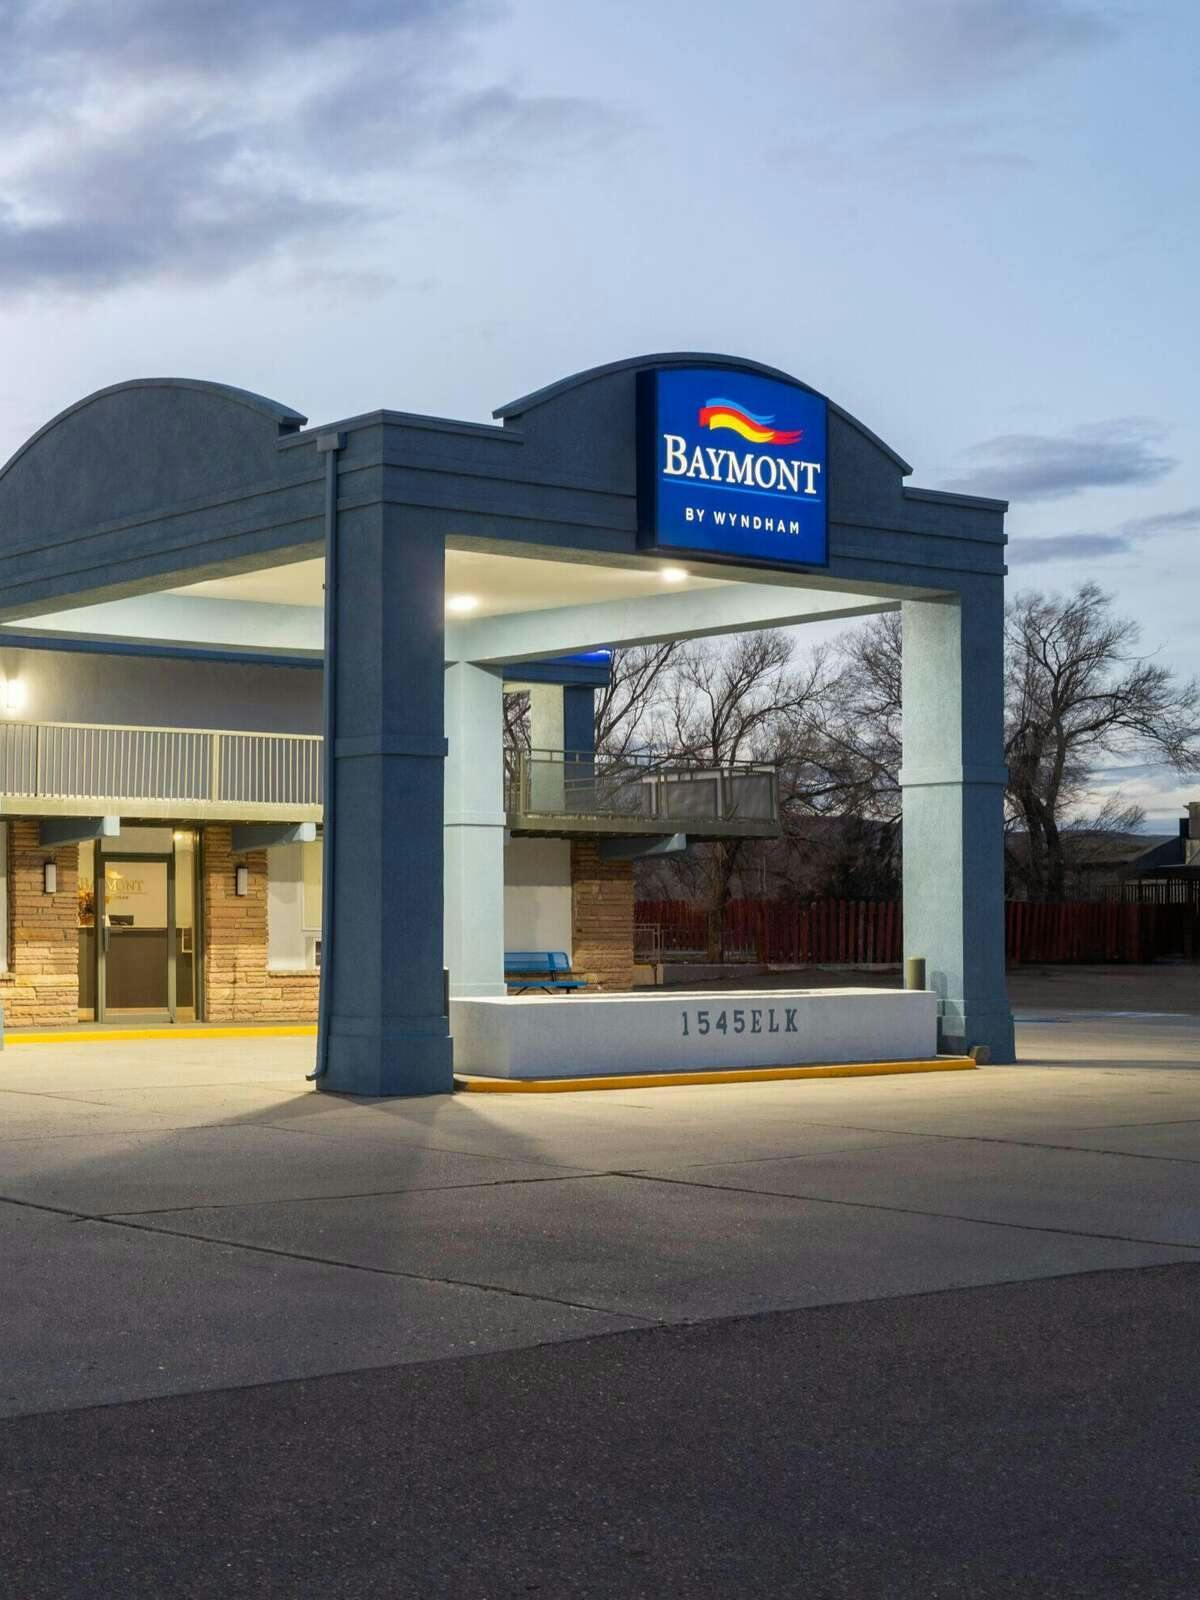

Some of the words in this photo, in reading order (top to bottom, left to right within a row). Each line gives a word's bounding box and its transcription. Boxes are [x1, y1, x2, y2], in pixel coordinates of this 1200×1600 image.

[663, 434, 821, 494] BAYMONT
[685, 507, 705, 523] BY
[714, 511, 800, 535] WYNDHAM
